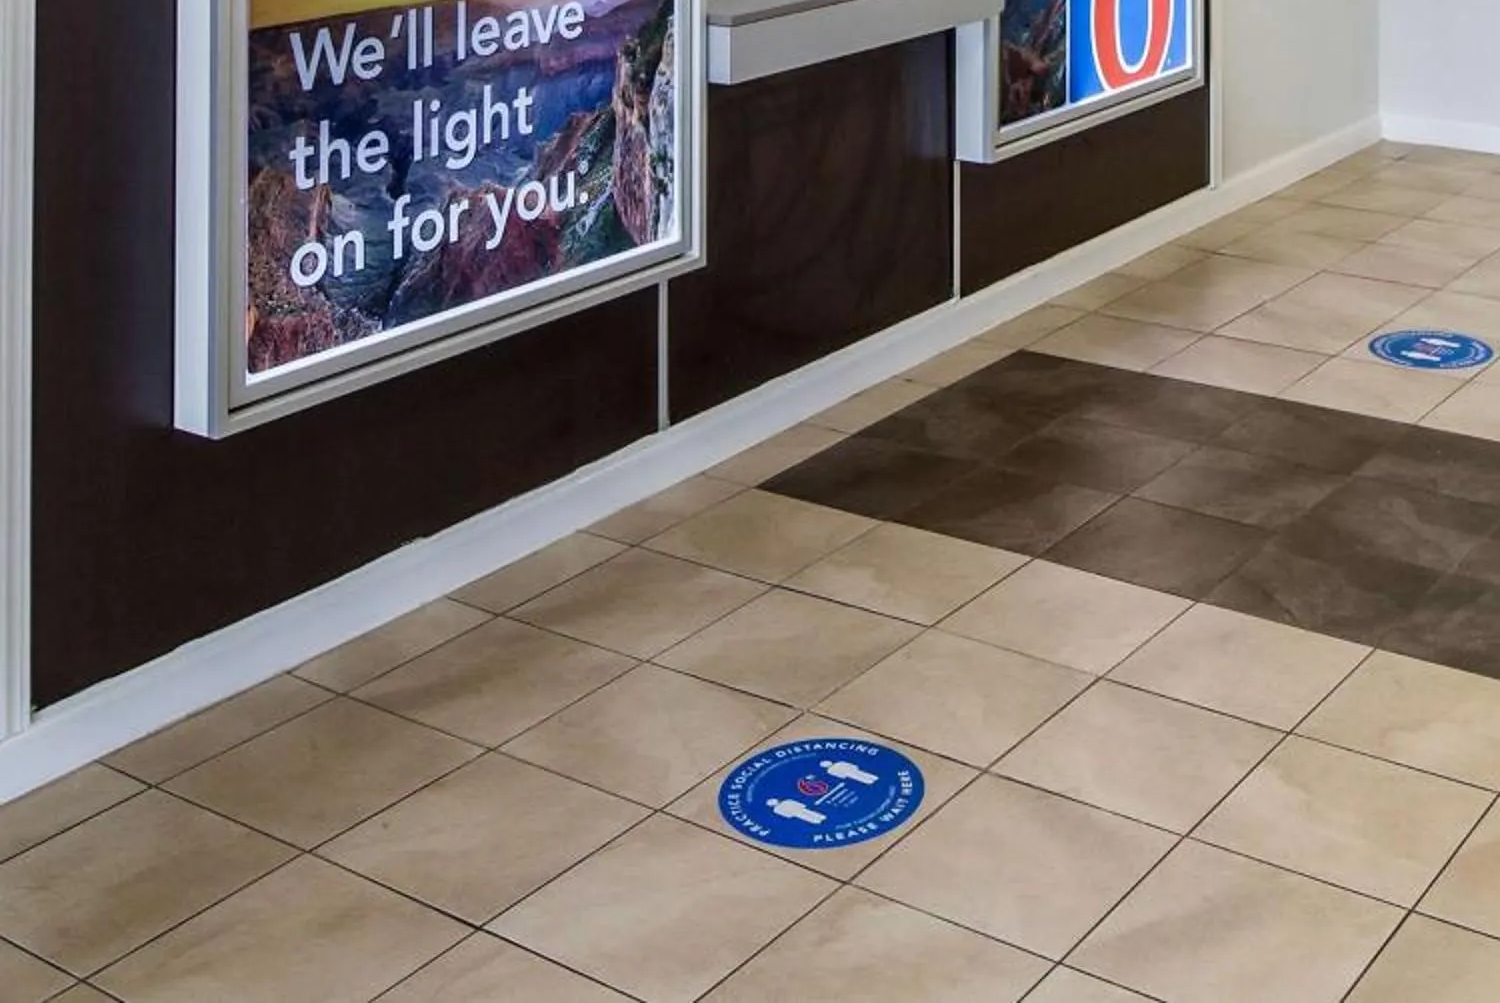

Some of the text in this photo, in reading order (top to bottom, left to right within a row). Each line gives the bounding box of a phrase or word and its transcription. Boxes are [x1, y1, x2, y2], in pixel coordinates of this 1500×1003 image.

[289, 0, 586, 91] We'll leave
[289, 85, 533, 190] the light
[290, 171, 589, 287] on for you.
[727, 740, 880, 837] PRACTICE SOCIAL DISTANCING
[813, 770, 913, 843] PLEASE WAIT HERE
